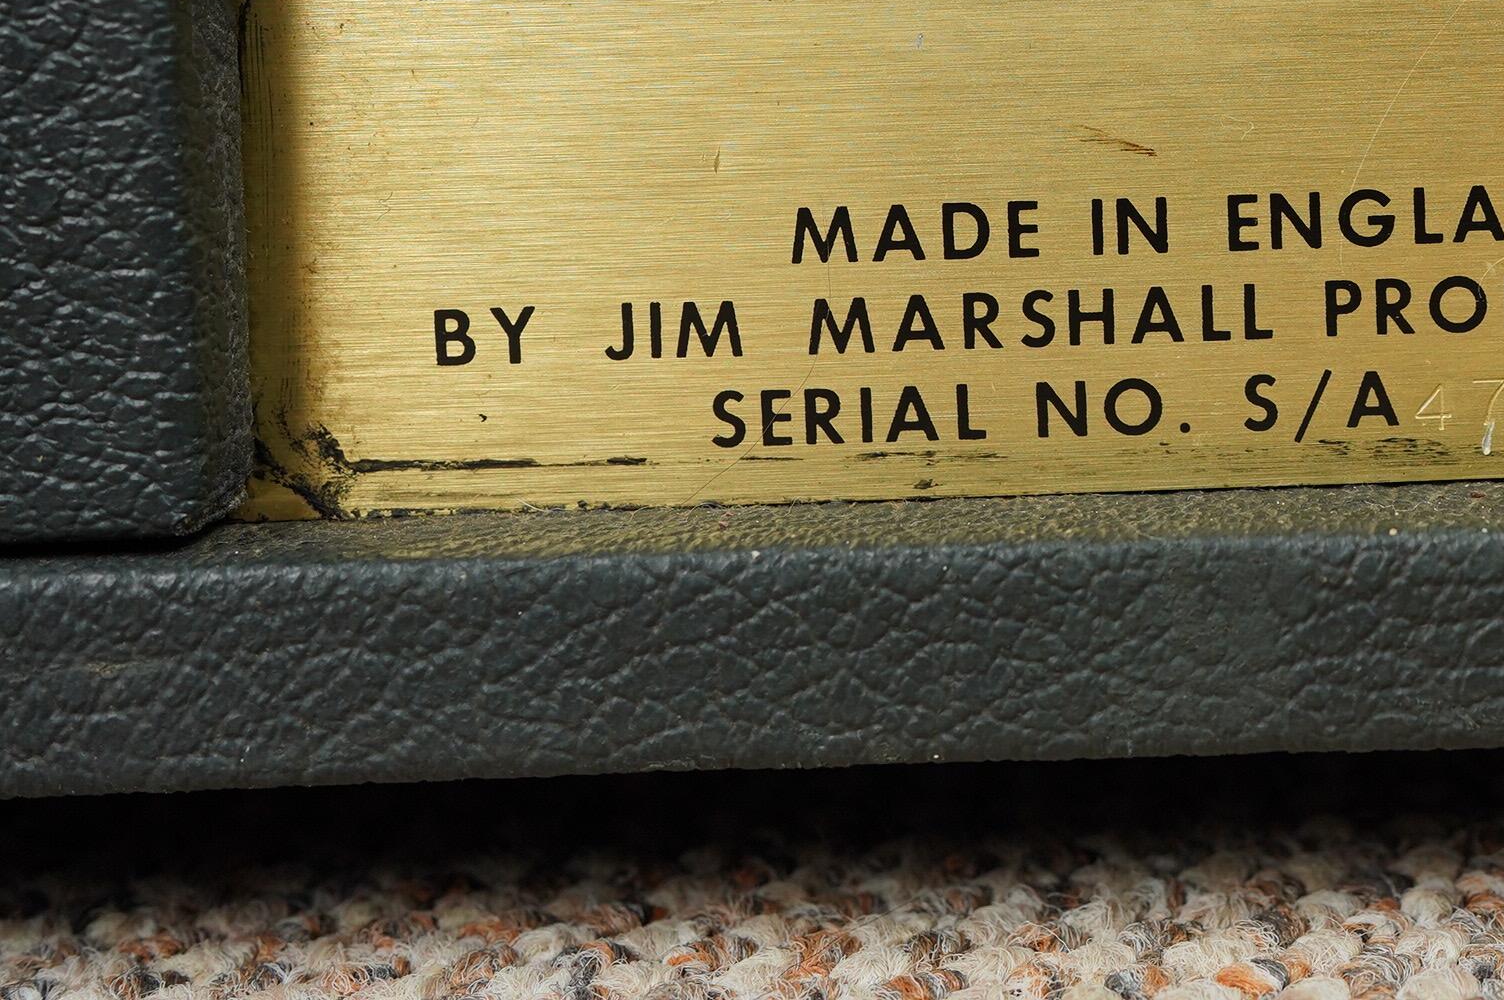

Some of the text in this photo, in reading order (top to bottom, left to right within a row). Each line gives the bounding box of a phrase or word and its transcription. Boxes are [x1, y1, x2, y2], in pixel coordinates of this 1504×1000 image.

[791, 200, 1040, 265] MADE
[1091, 196, 1169, 256] IN
[434, 305, 535, 367] BY
[604, 300, 743, 361] JIM
[808, 285, 1274, 356] MARSHALL
[711, 383, 987, 448] SERIAL
[1035, 377, 1191, 438] NO.
